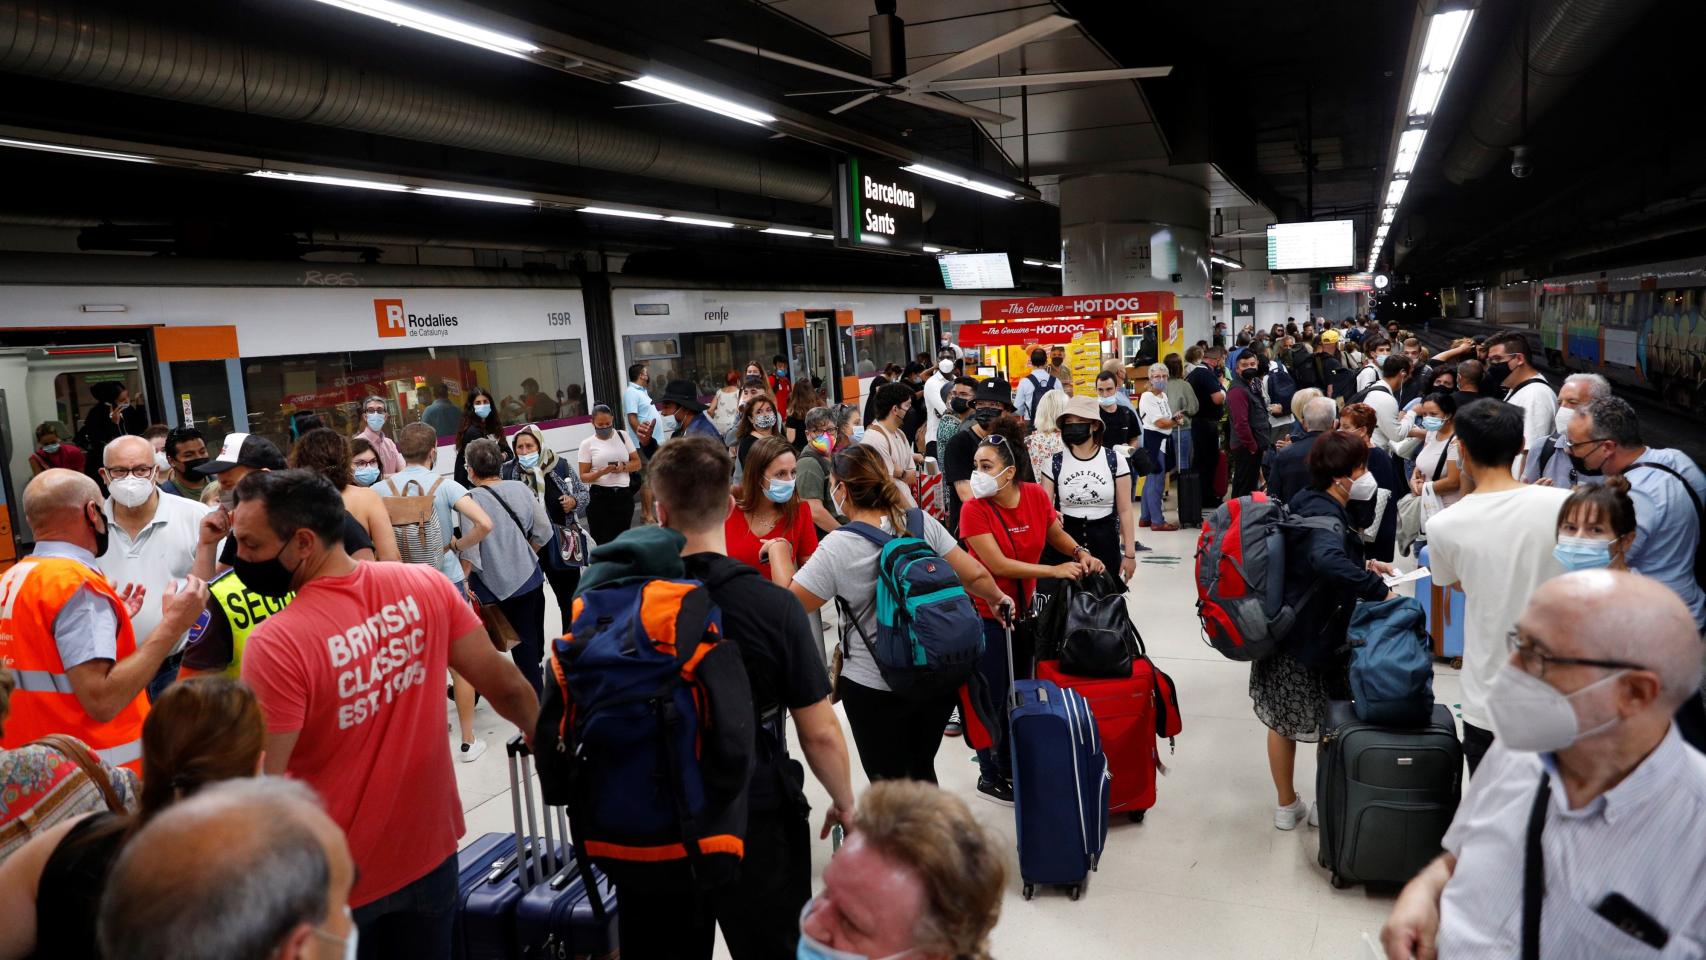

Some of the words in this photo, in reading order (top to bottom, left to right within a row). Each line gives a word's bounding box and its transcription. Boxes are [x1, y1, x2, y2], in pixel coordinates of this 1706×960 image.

[864, 175, 915, 208] Barcelona
[865, 208, 896, 235] Sants
[1008, 303, 1024, 314] The
[1026, 302, 1064, 314] Genuine
[1073, 299, 1102, 313] HOT
[1104, 297, 1139, 311] DOG
[386, 305, 405, 328] R
[408, 314, 458, 327] Rodalies
[547, 312, 571, 326] 159R
[704, 305, 729, 325] renfe
[409, 329, 418, 337] de
[418, 328, 449, 337] Catalunya
[1036, 325, 1059, 334] HOT
[1059, 324, 1084, 334] DOG
[1063, 470, 1085, 485] GREAT
[1086, 470, 1106, 486] FALLS
[328, 595, 421, 668] BRITISH
[338, 628, 425, 699] CLASSIC
